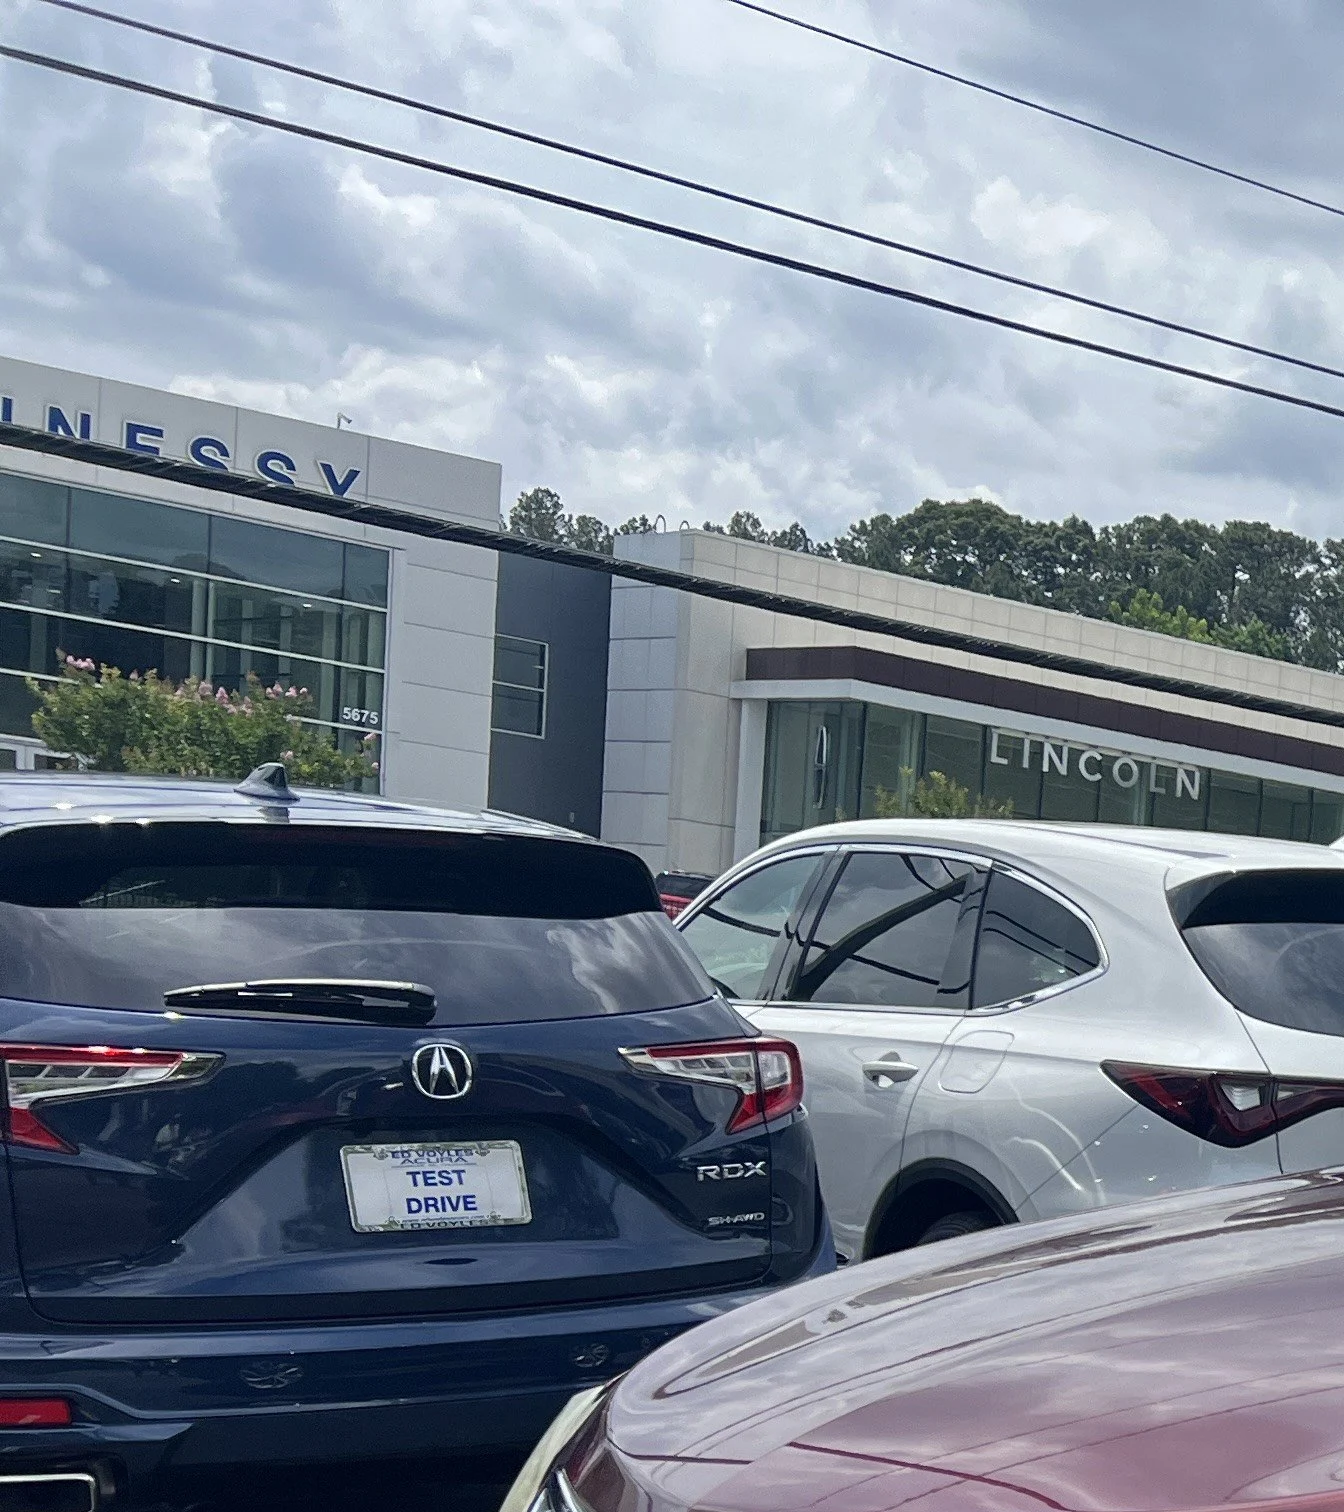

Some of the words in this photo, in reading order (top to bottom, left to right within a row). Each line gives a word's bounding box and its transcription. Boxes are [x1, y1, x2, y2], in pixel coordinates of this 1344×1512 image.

[342, 706, 379, 725] 5675
[990, 730, 1200, 800] LINCOLN
[390, 1150, 411, 1159] ED
[417, 1148, 474, 1158] VOYLES
[400, 1156, 469, 1165] ACURA
[406, 1169, 466, 1188] TEST
[697, 1161, 767, 1181] RDX
[406, 1194, 478, 1214] DRIVE
